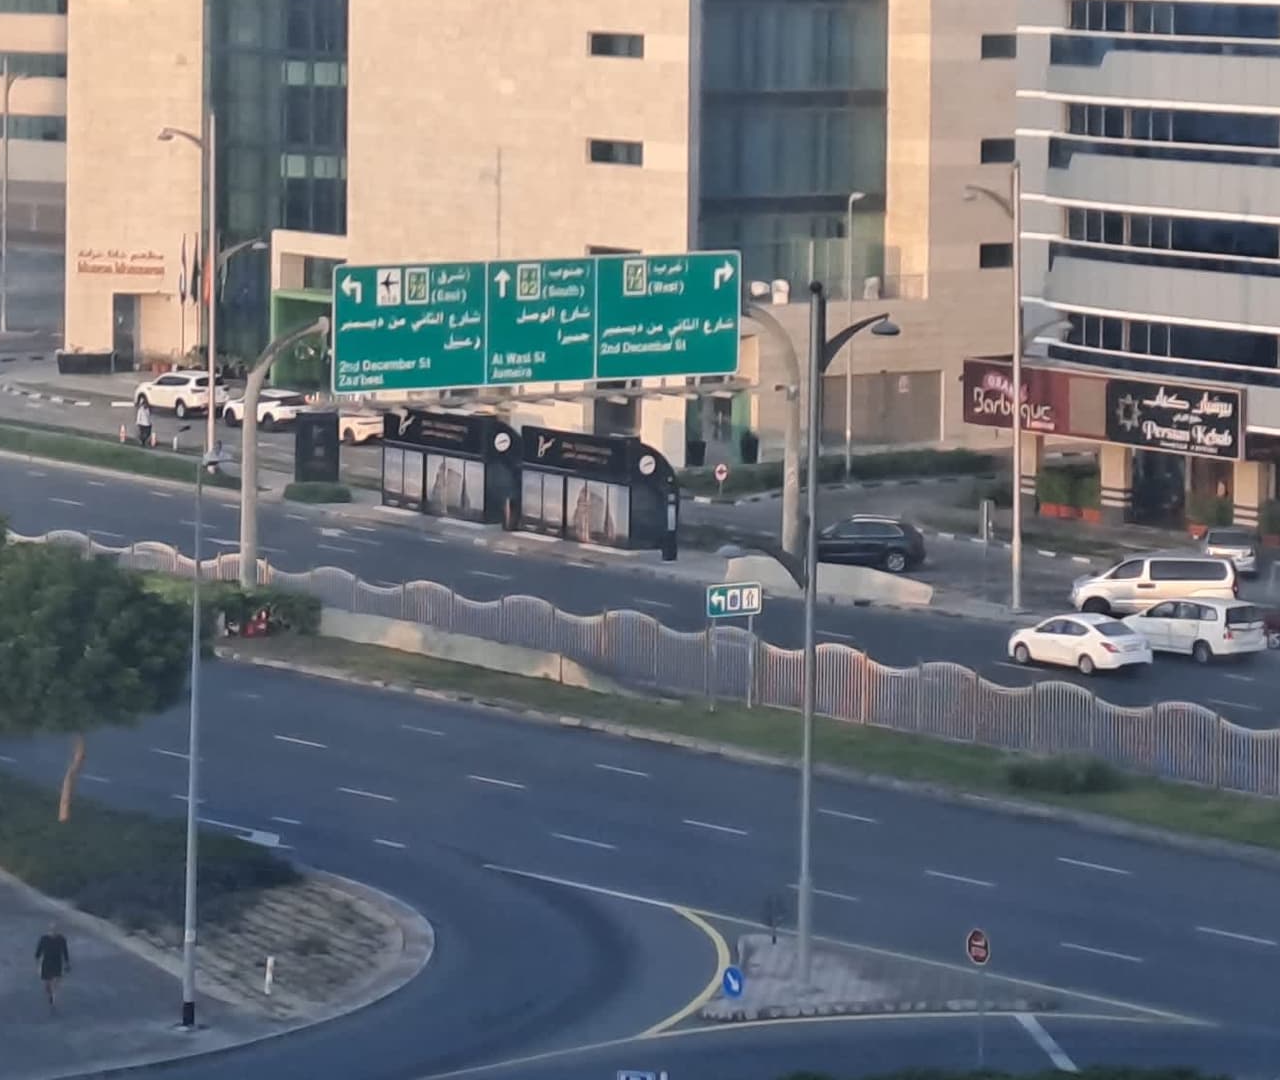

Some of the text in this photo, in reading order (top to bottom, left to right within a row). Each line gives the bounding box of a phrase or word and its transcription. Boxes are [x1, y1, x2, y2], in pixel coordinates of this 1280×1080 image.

[600, 342, 620, 355] 2nd
[338, 360, 360, 374] 2nd
[362, 357, 416, 372] December
